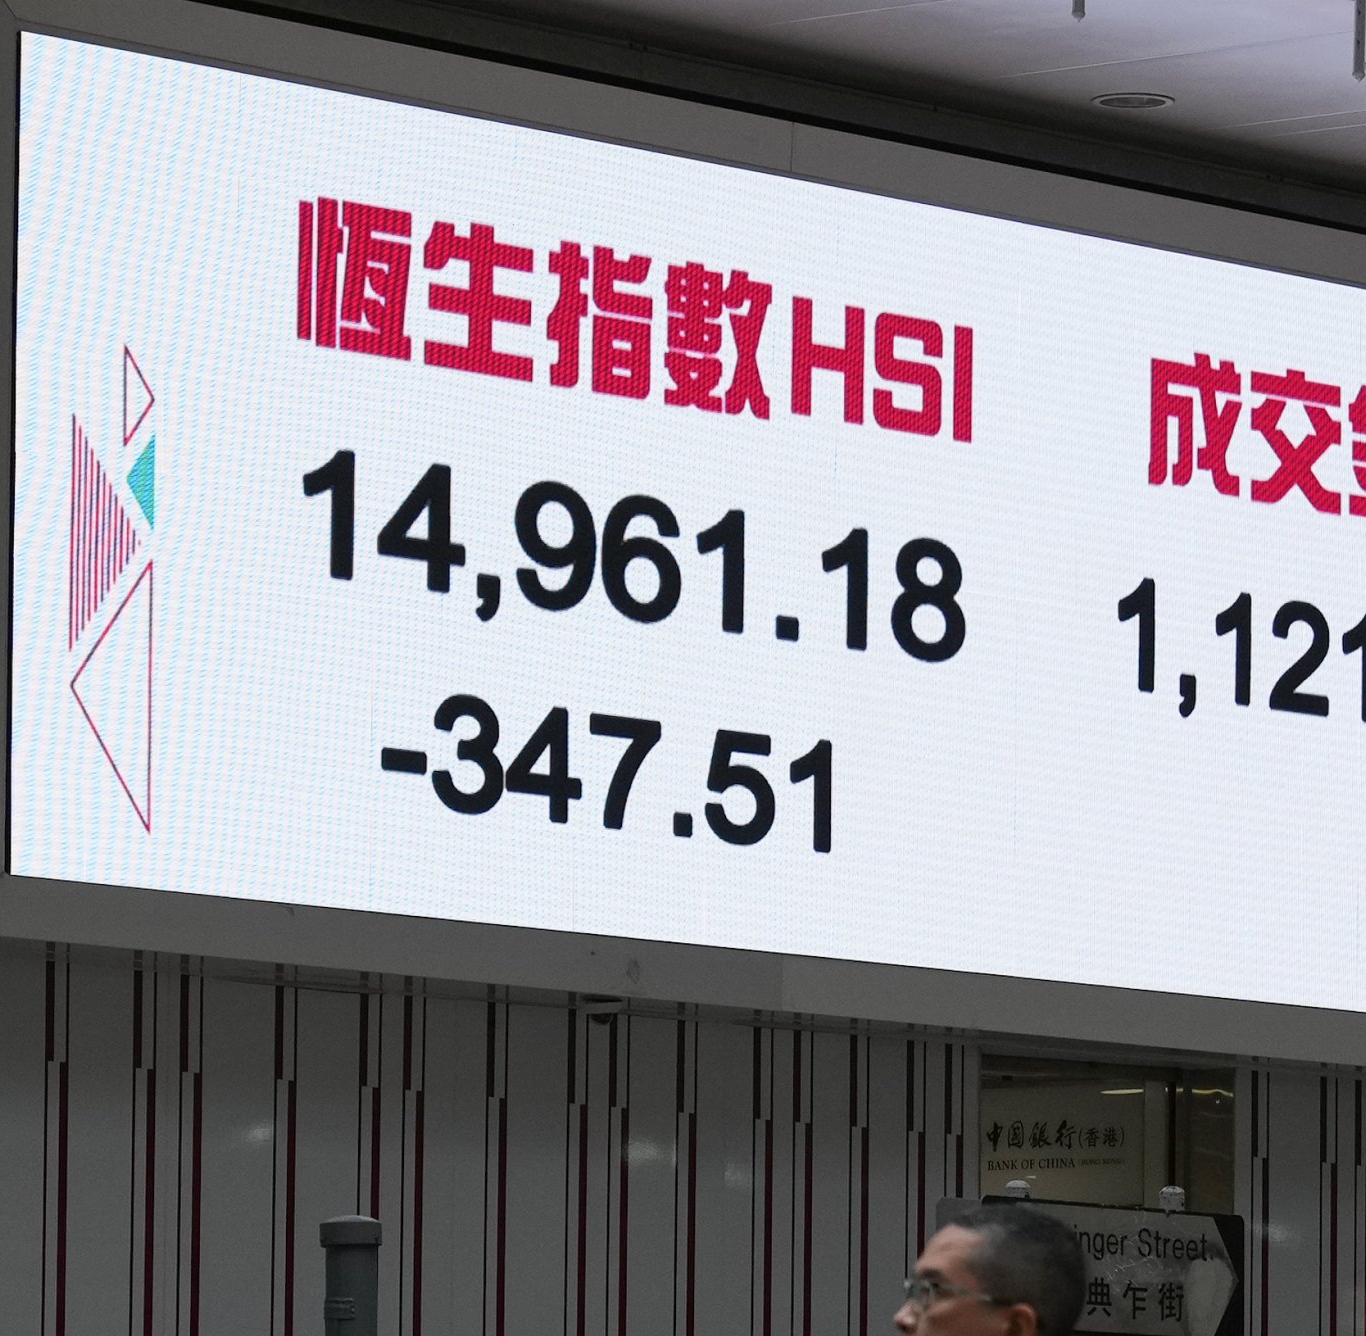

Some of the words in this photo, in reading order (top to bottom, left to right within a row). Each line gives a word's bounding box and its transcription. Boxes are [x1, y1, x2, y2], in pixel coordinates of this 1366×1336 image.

[297, 197, 772, 420] 恆生指數
[791, 296, 973, 443] HSI
[303, 450, 966, 663] 14,961.18
[381, 694, 832, 854] -347.51
[987, 1160, 1017, 1171] BANK
[1020, 1159, 1035, 1170] OF
[1038, 1158, 1075, 1169] CHINA
[1138, 1228, 1207, 1262] Street
[1086, 1277, 1184, 1322] 典乍街
